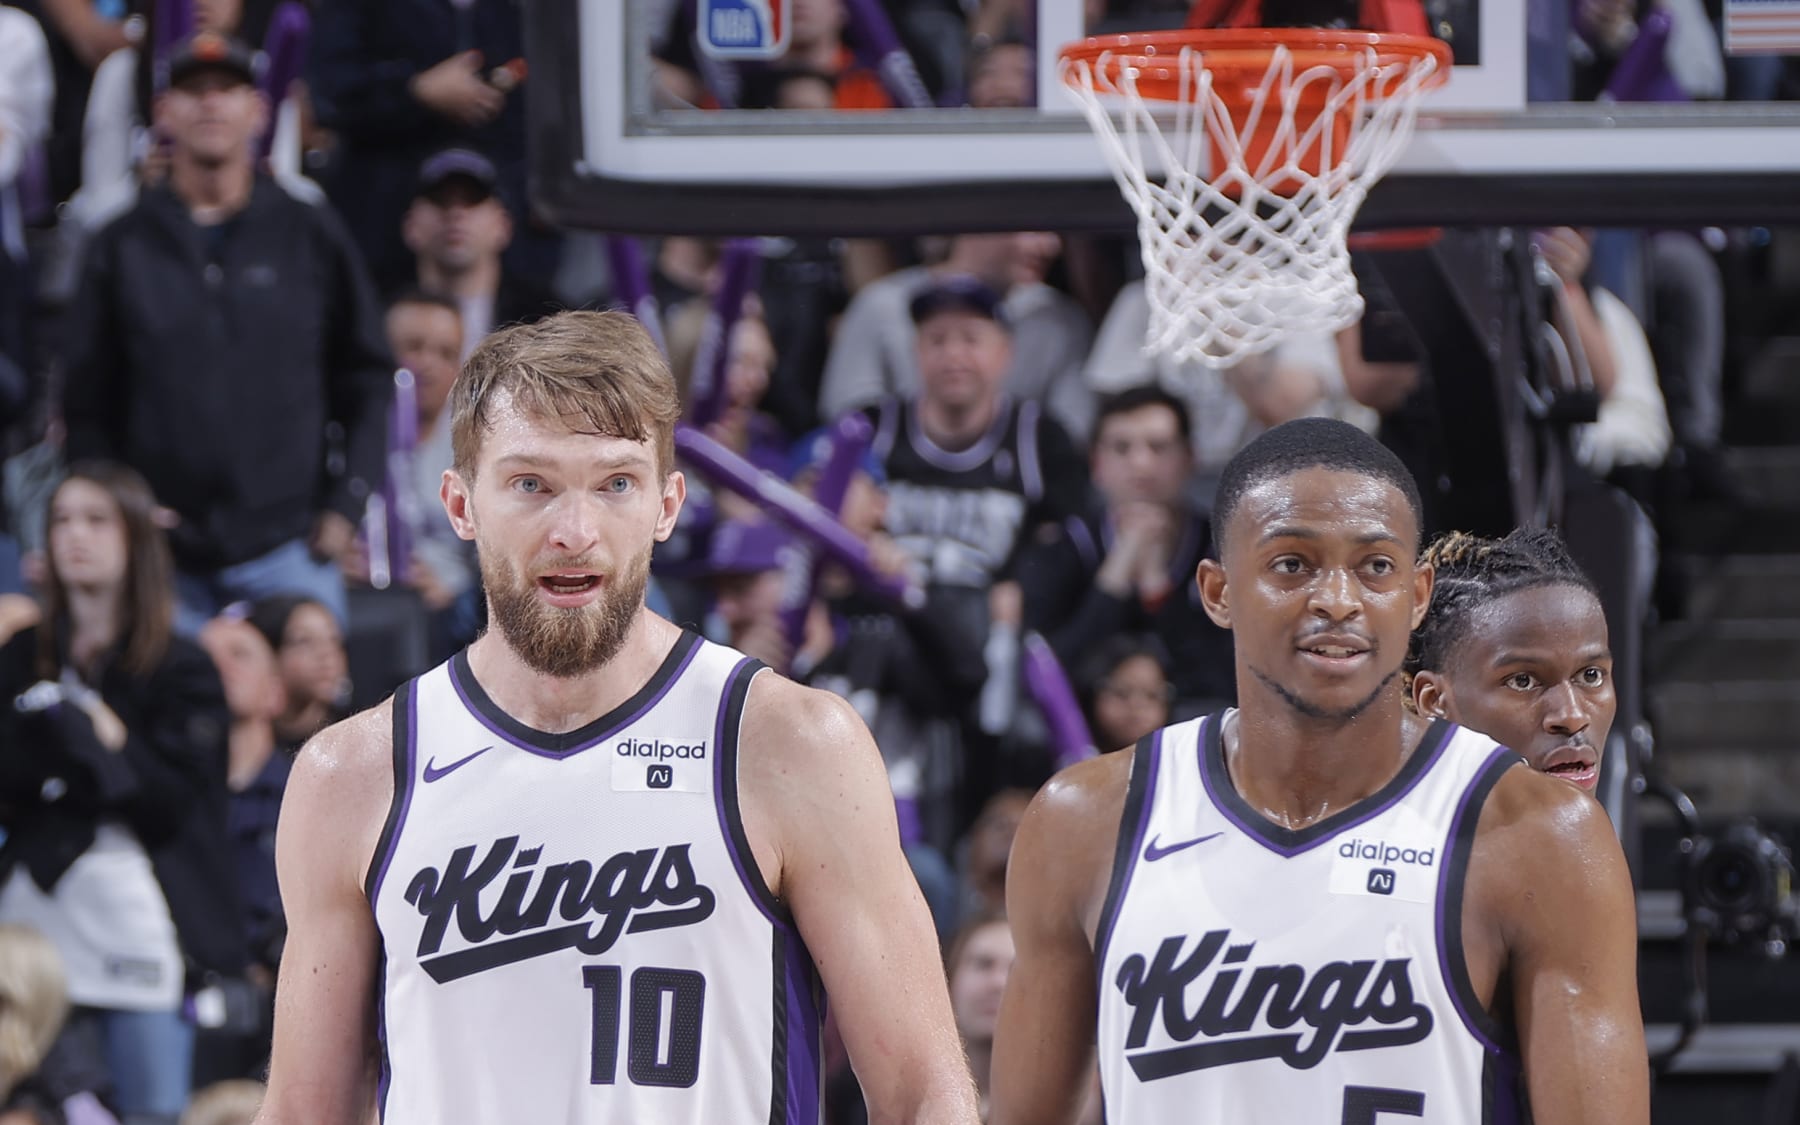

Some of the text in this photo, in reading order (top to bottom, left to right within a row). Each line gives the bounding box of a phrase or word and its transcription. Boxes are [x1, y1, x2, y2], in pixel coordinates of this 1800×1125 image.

[710, 7, 759, 43] NBA
[616, 738, 706, 762] dialpad
[1338, 838, 1435, 866] dialpad
[403, 834, 716, 984] Kings
[582, 964, 706, 1088] 10
[1115, 928, 1434, 1082] Kings
